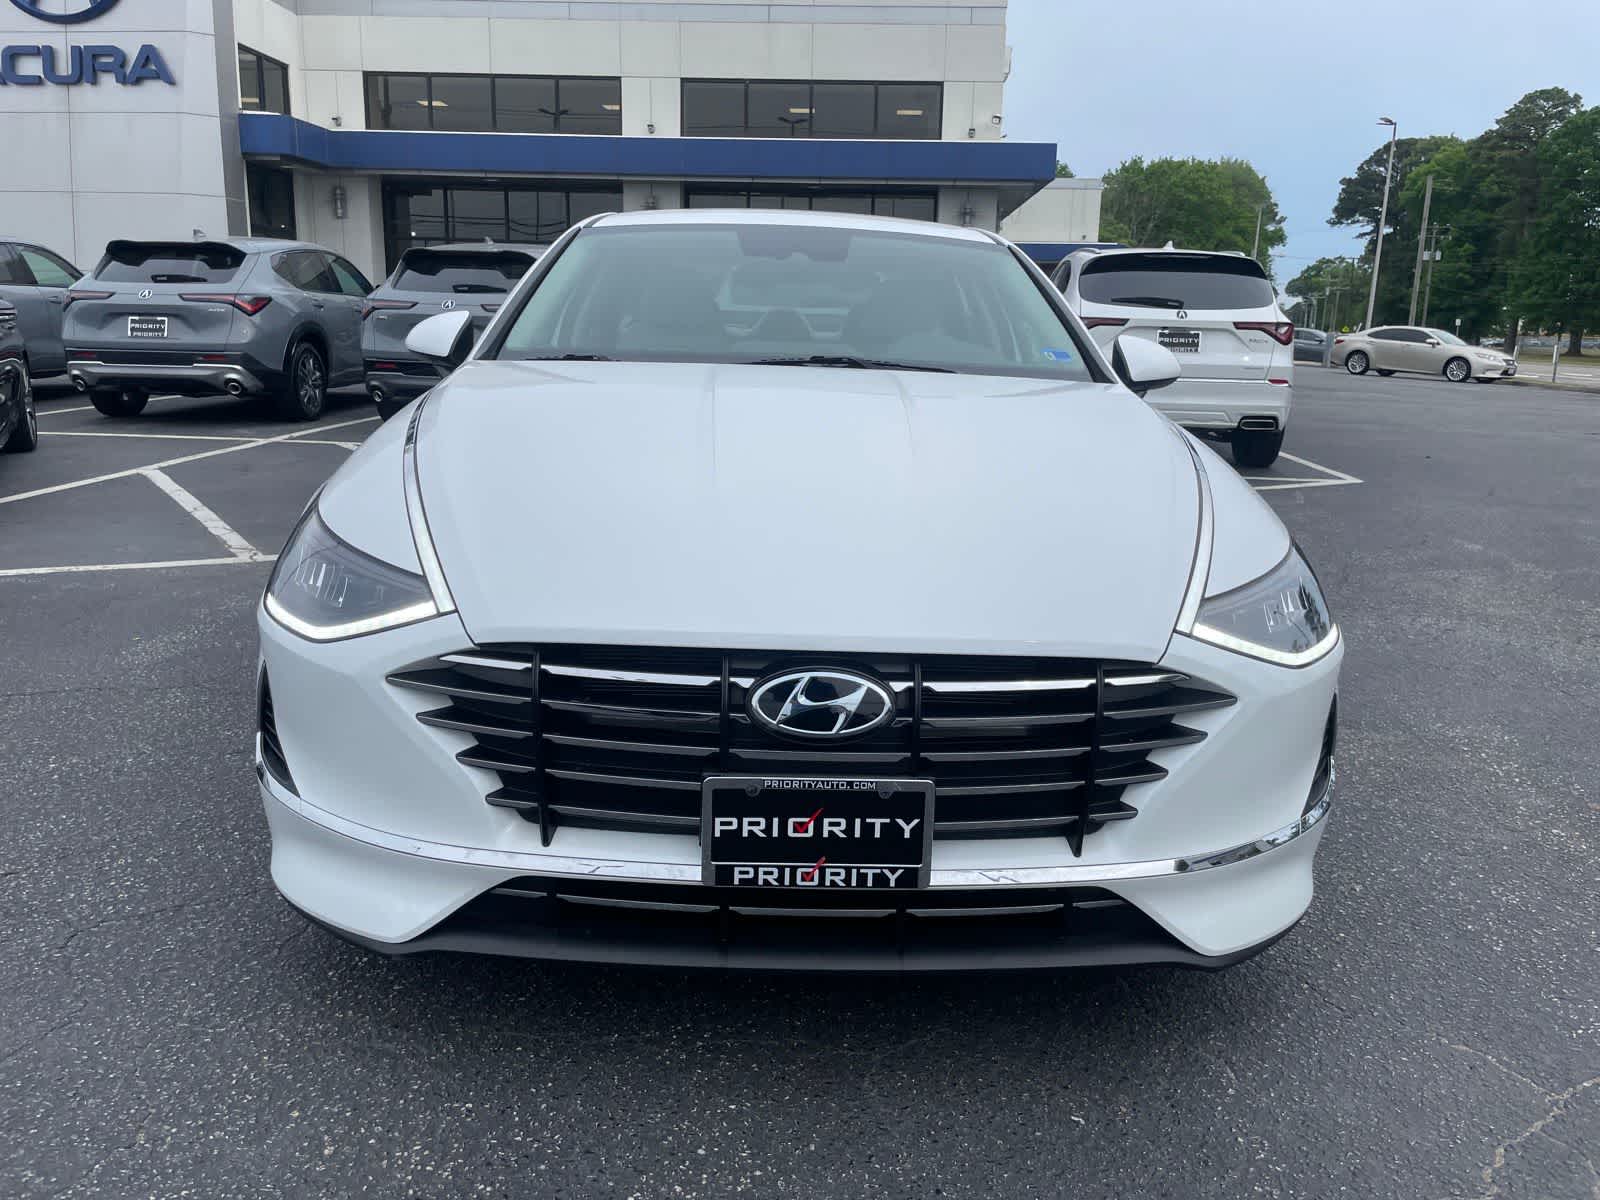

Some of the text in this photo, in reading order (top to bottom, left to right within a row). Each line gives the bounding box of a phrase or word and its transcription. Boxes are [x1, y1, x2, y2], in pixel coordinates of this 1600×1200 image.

[0, 44, 176, 86] CURA
[714, 815, 921, 839] PRIORITY
[733, 865, 905, 887] PRIORITY
